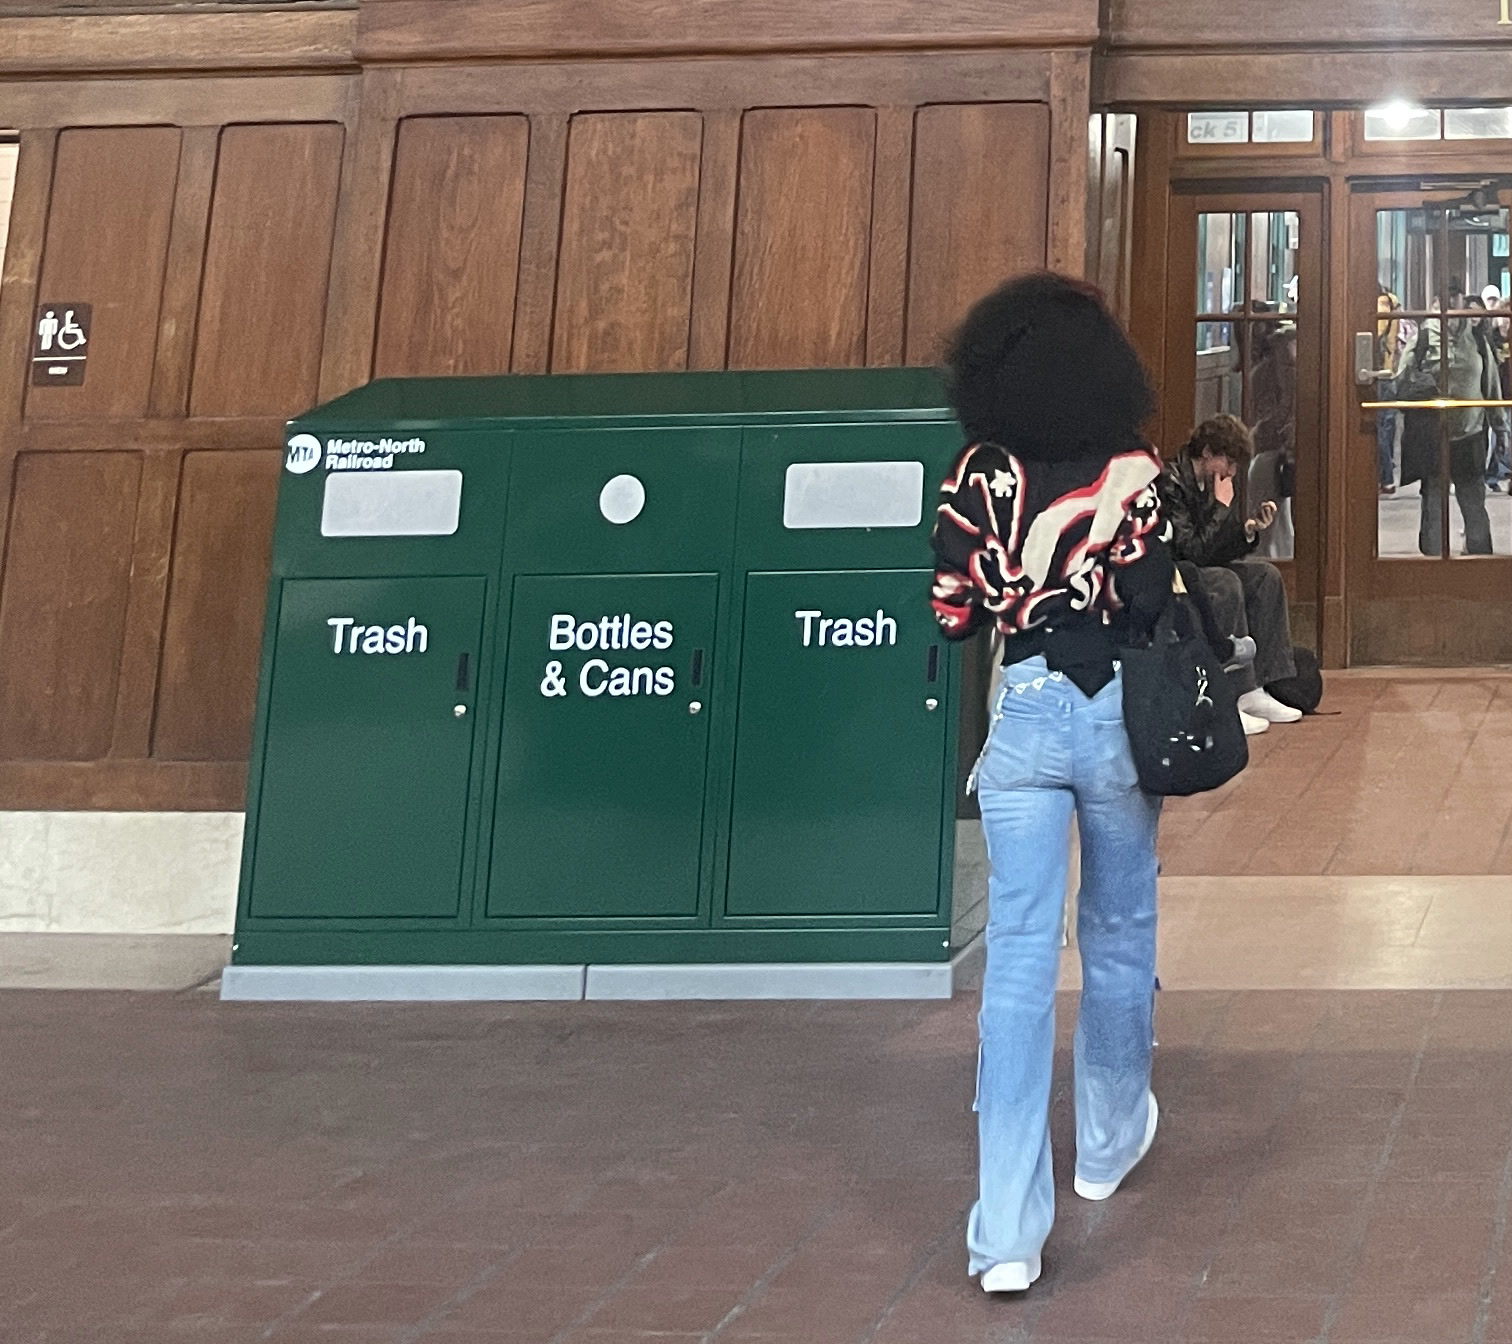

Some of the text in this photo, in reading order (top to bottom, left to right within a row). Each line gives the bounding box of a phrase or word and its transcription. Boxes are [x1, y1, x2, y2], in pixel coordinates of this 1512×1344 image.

[325, 453, 394, 470] Railroad
[326, 437, 426, 455] Metro-North
[327, 616, 428, 654] Trash
[549, 613, 674, 651] Bottles
[794, 609, 897, 647] Trash
[540, 658, 675, 697] & Cans
